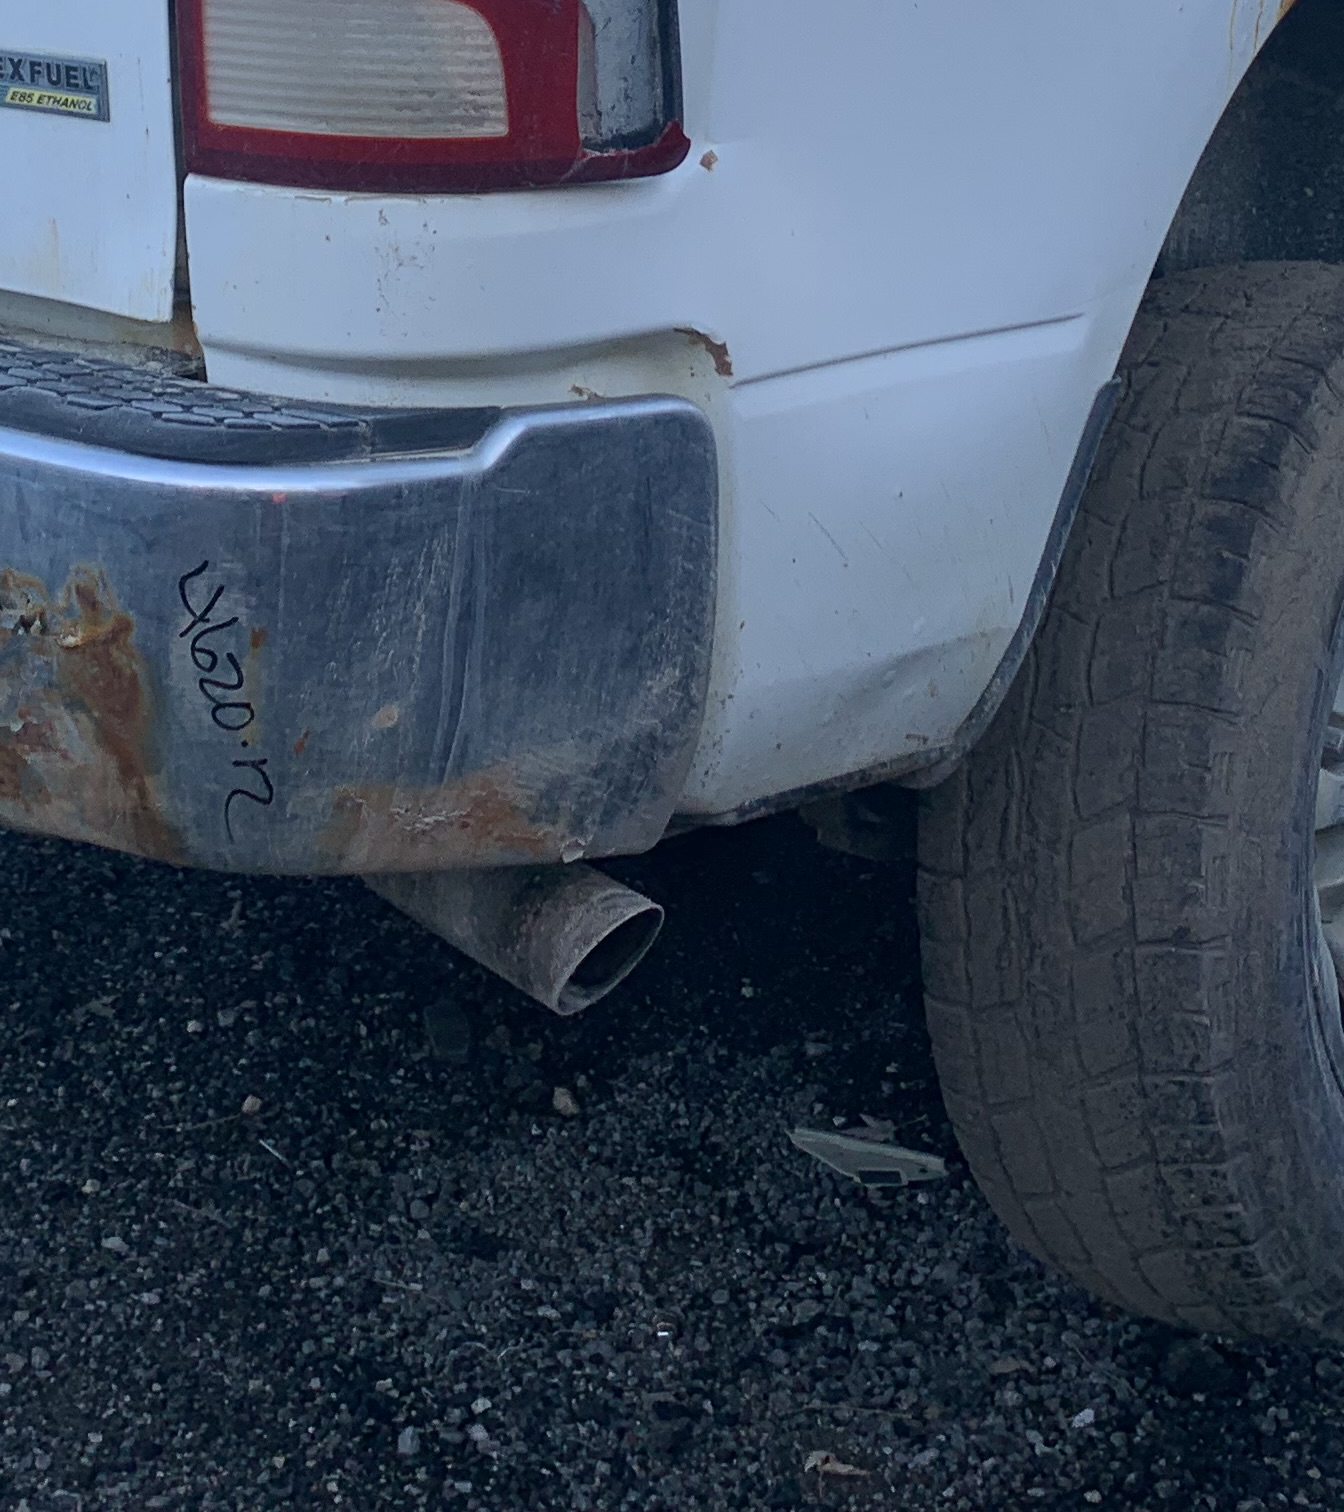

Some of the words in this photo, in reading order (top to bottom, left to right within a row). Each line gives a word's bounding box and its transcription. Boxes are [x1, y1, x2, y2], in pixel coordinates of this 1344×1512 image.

[9, 90, 35, 104] E85
[36, 93, 94, 112] ETHANOL
[178, 559, 275, 844] 4620.12
